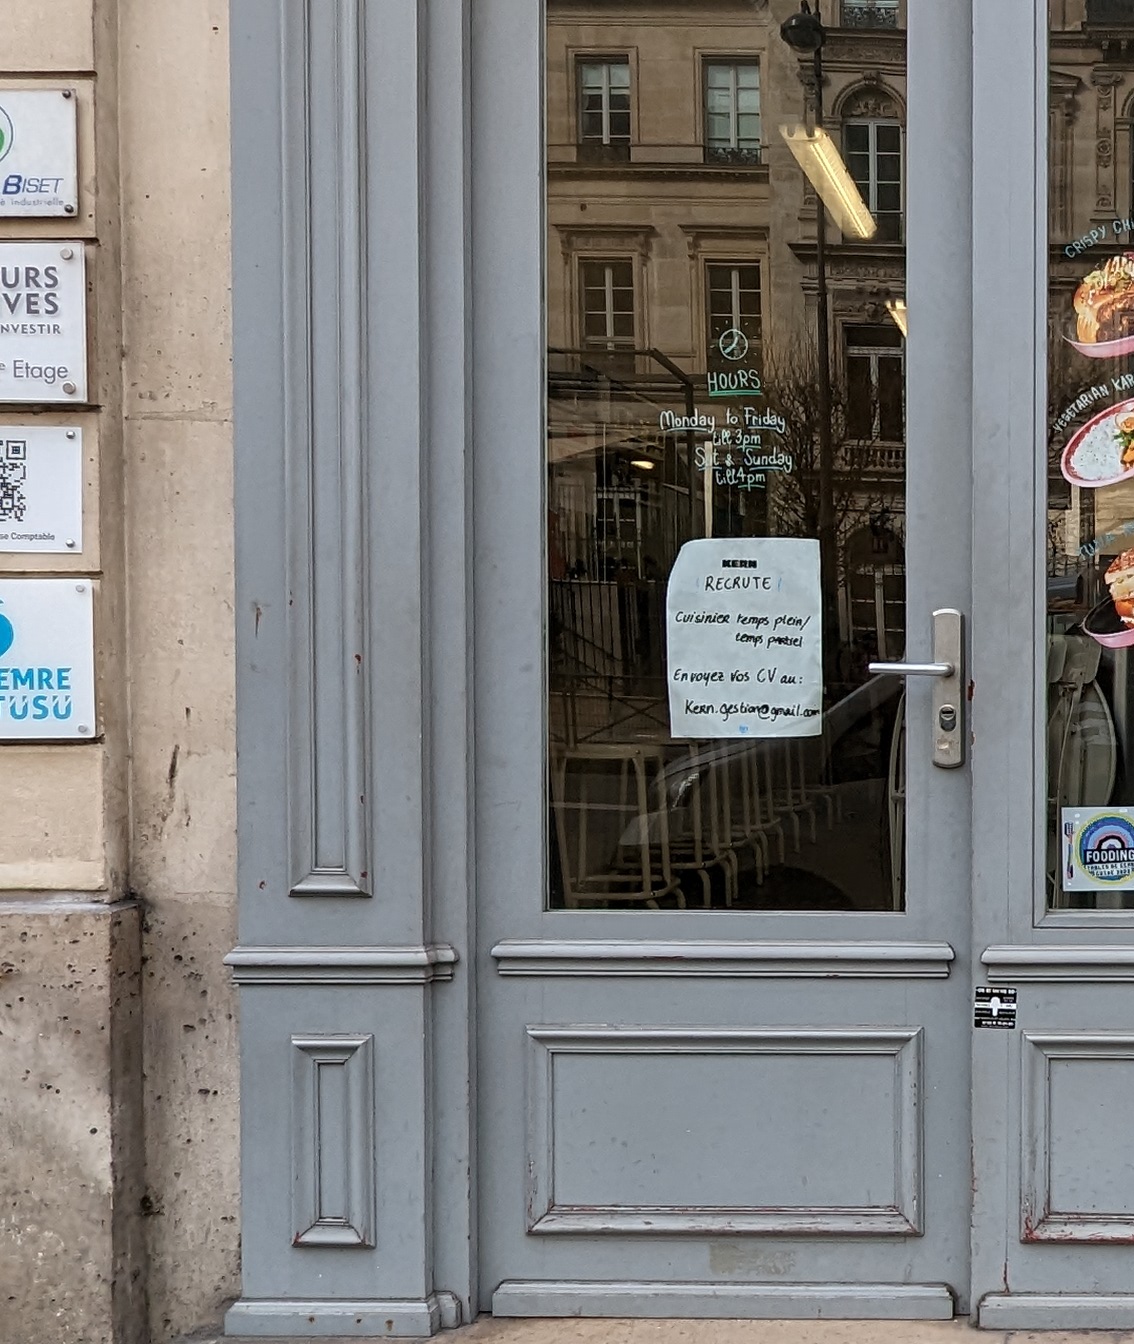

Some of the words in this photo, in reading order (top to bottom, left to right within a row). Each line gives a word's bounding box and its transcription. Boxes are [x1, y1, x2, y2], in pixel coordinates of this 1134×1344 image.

[2, 174, 64, 195] BISET
[1064, 225, 1106, 259] CRISPY
[13, 359, 69, 385] Etage
[707, 369, 761, 392] HOURS
[660, 408, 715, 433] Monday
[726, 408, 738, 425] to
[744, 407, 786, 433] Friday
[1052, 384, 1109, 433] VEGETARIAN
[744, 447, 793, 473] Sunday
[704, 575, 771, 591] RECRUTE
[0, 667, 72, 690] EMRE
[756, 667, 777, 684] CV
